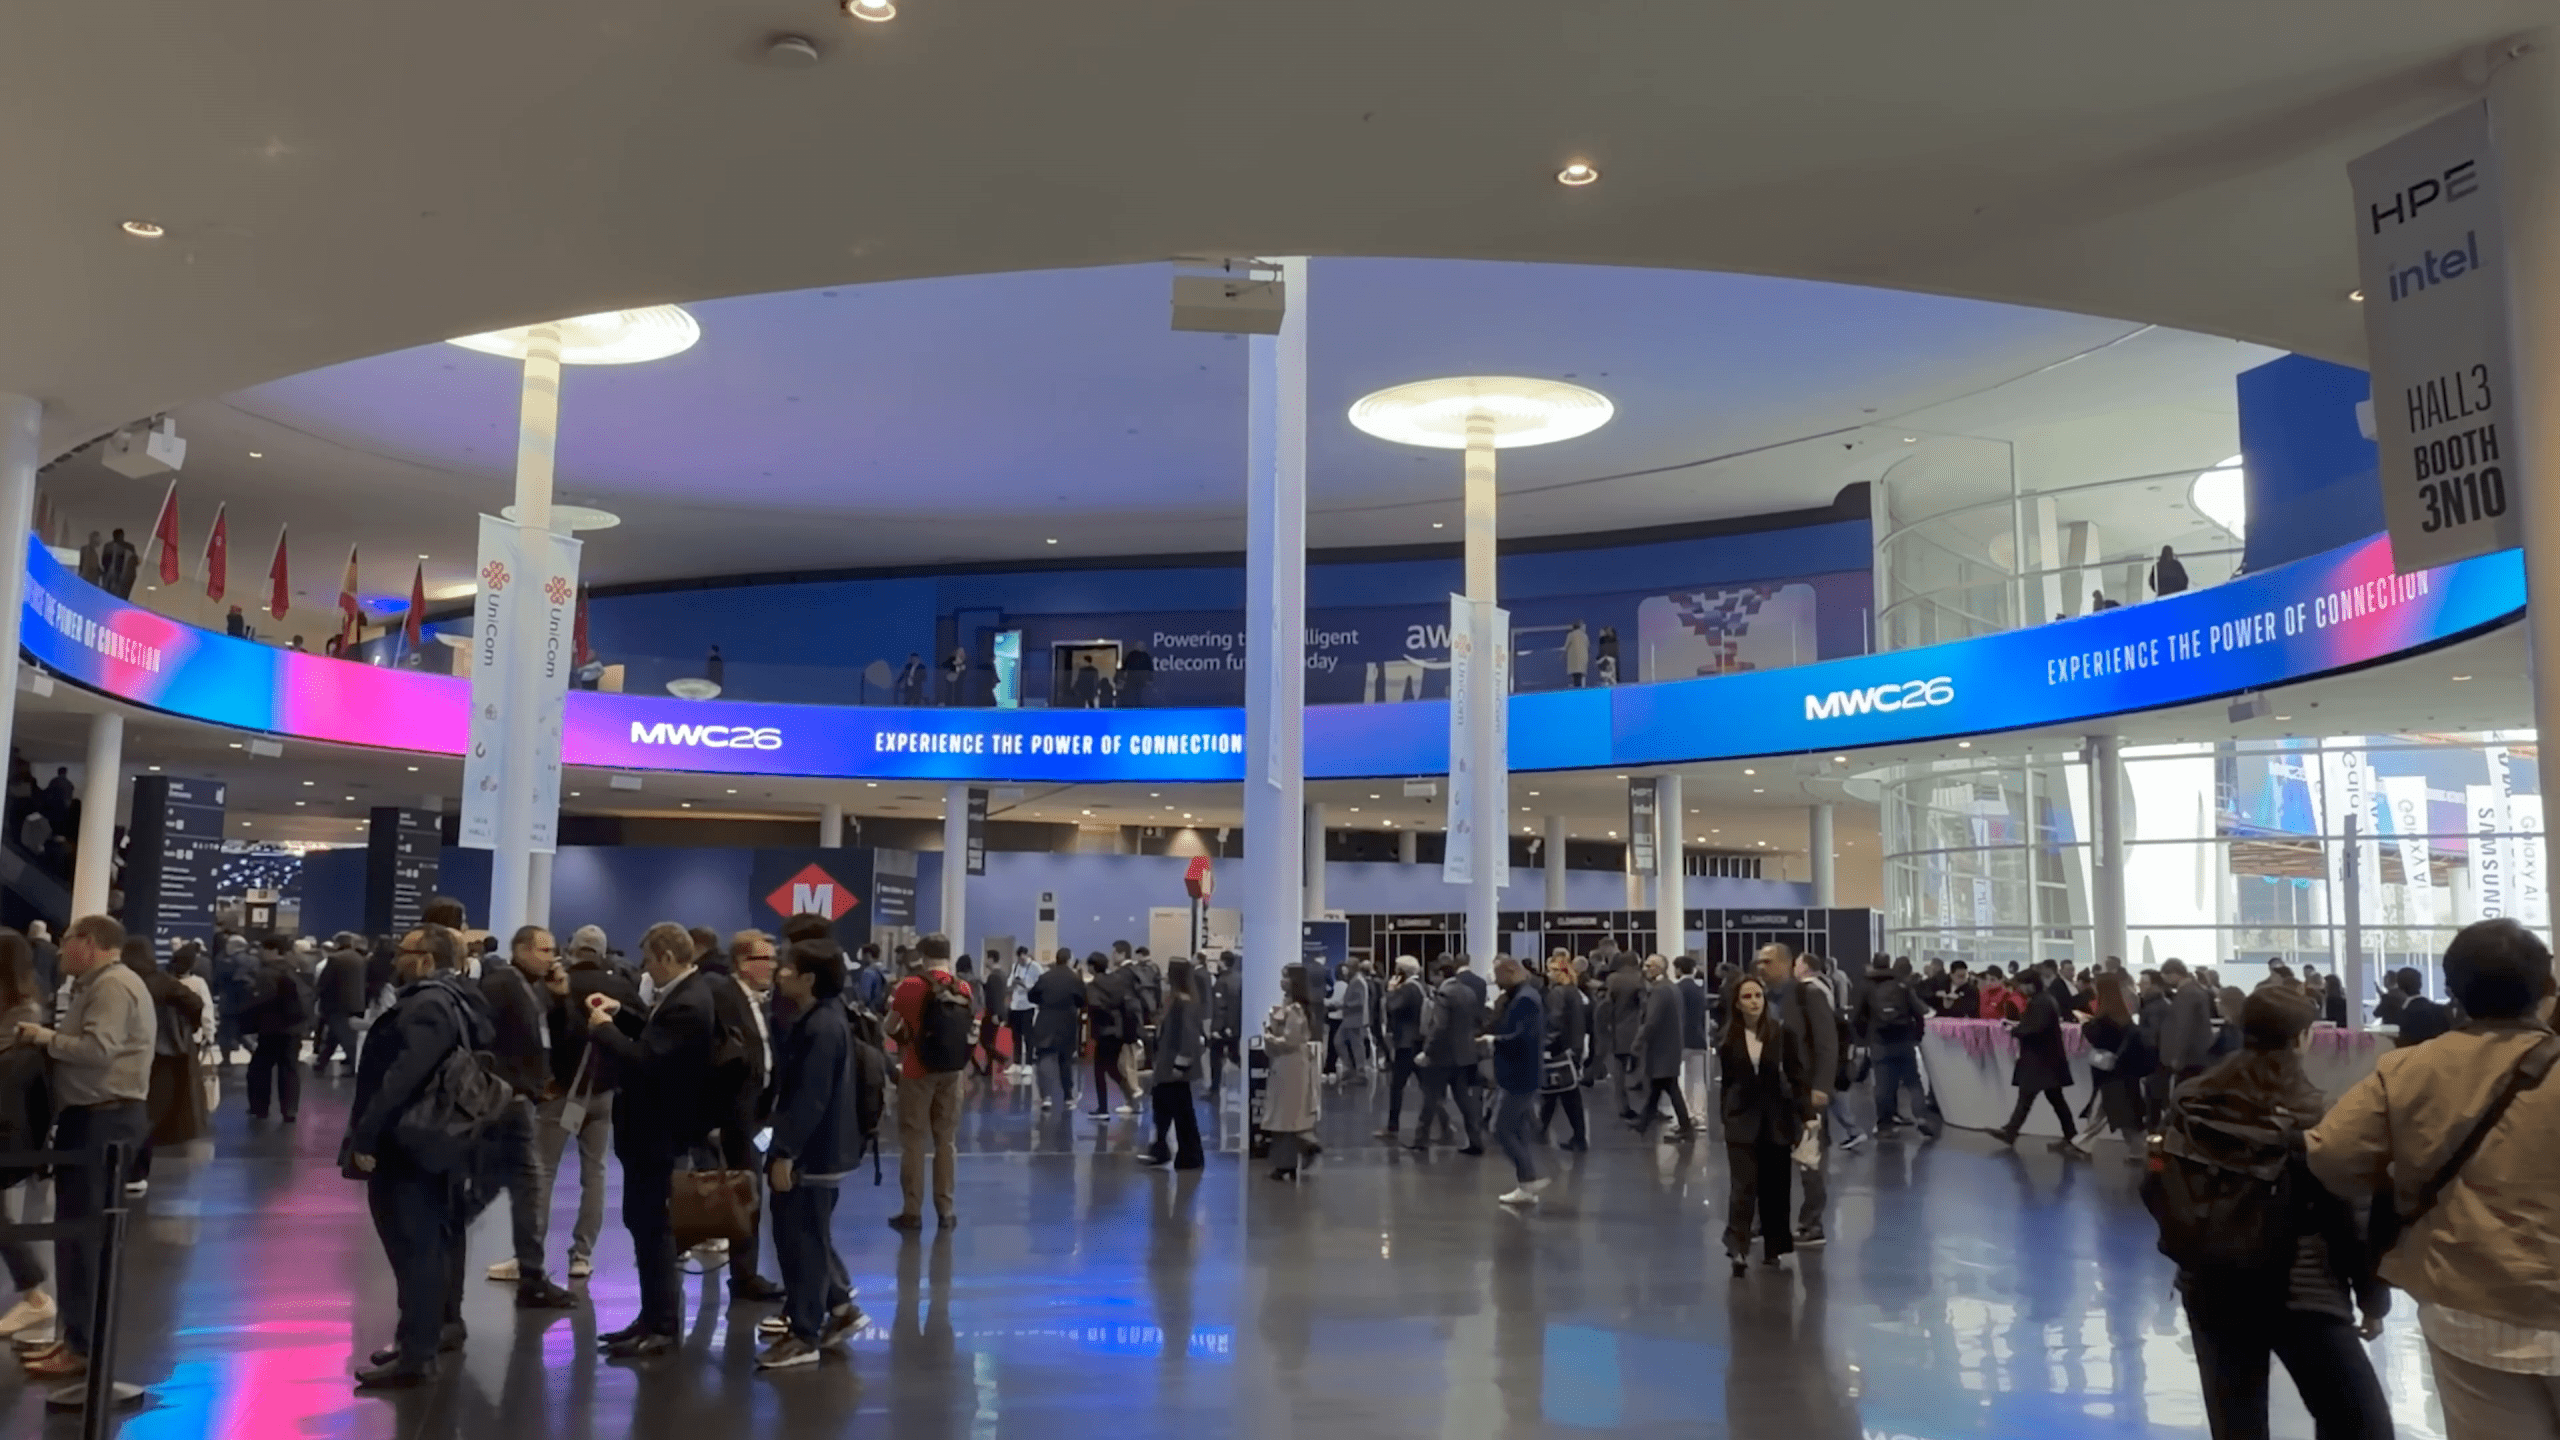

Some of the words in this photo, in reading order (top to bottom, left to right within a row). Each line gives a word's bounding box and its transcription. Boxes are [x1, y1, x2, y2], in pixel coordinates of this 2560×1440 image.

[2371, 160, 2479, 234] HPE
[2389, 230, 2480, 302] intel
[2414, 424, 2500, 482] BOOTH
[2419, 466, 2507, 533] 3N10
[483, 593, 500, 666] UniCom
[546, 607, 561, 678] UniCom
[1153, 631, 1233, 651] Powering
[1405, 624, 1451, 649] aw
[2047, 638, 2160, 686] EXPERIENCE
[2168, 629, 2202, 663] THE
[2211, 612, 2277, 654] POWER
[2285, 602, 2308, 636] OF
[2316, 570, 2429, 629] CONNECTION
[1152, 654, 1221, 671] telecom
[1805, 677, 1954, 720] MWC26
[631, 721, 783, 751] MWC26
[875, 732, 984, 753] EXPERIENCE
[993, 734, 1023, 754] THE
[1031, 734, 1094, 755] POWER
[1102, 735, 1123, 755] OF
[1129, 733, 1244, 755] CONNECTION
[793, 883, 834, 921] M
